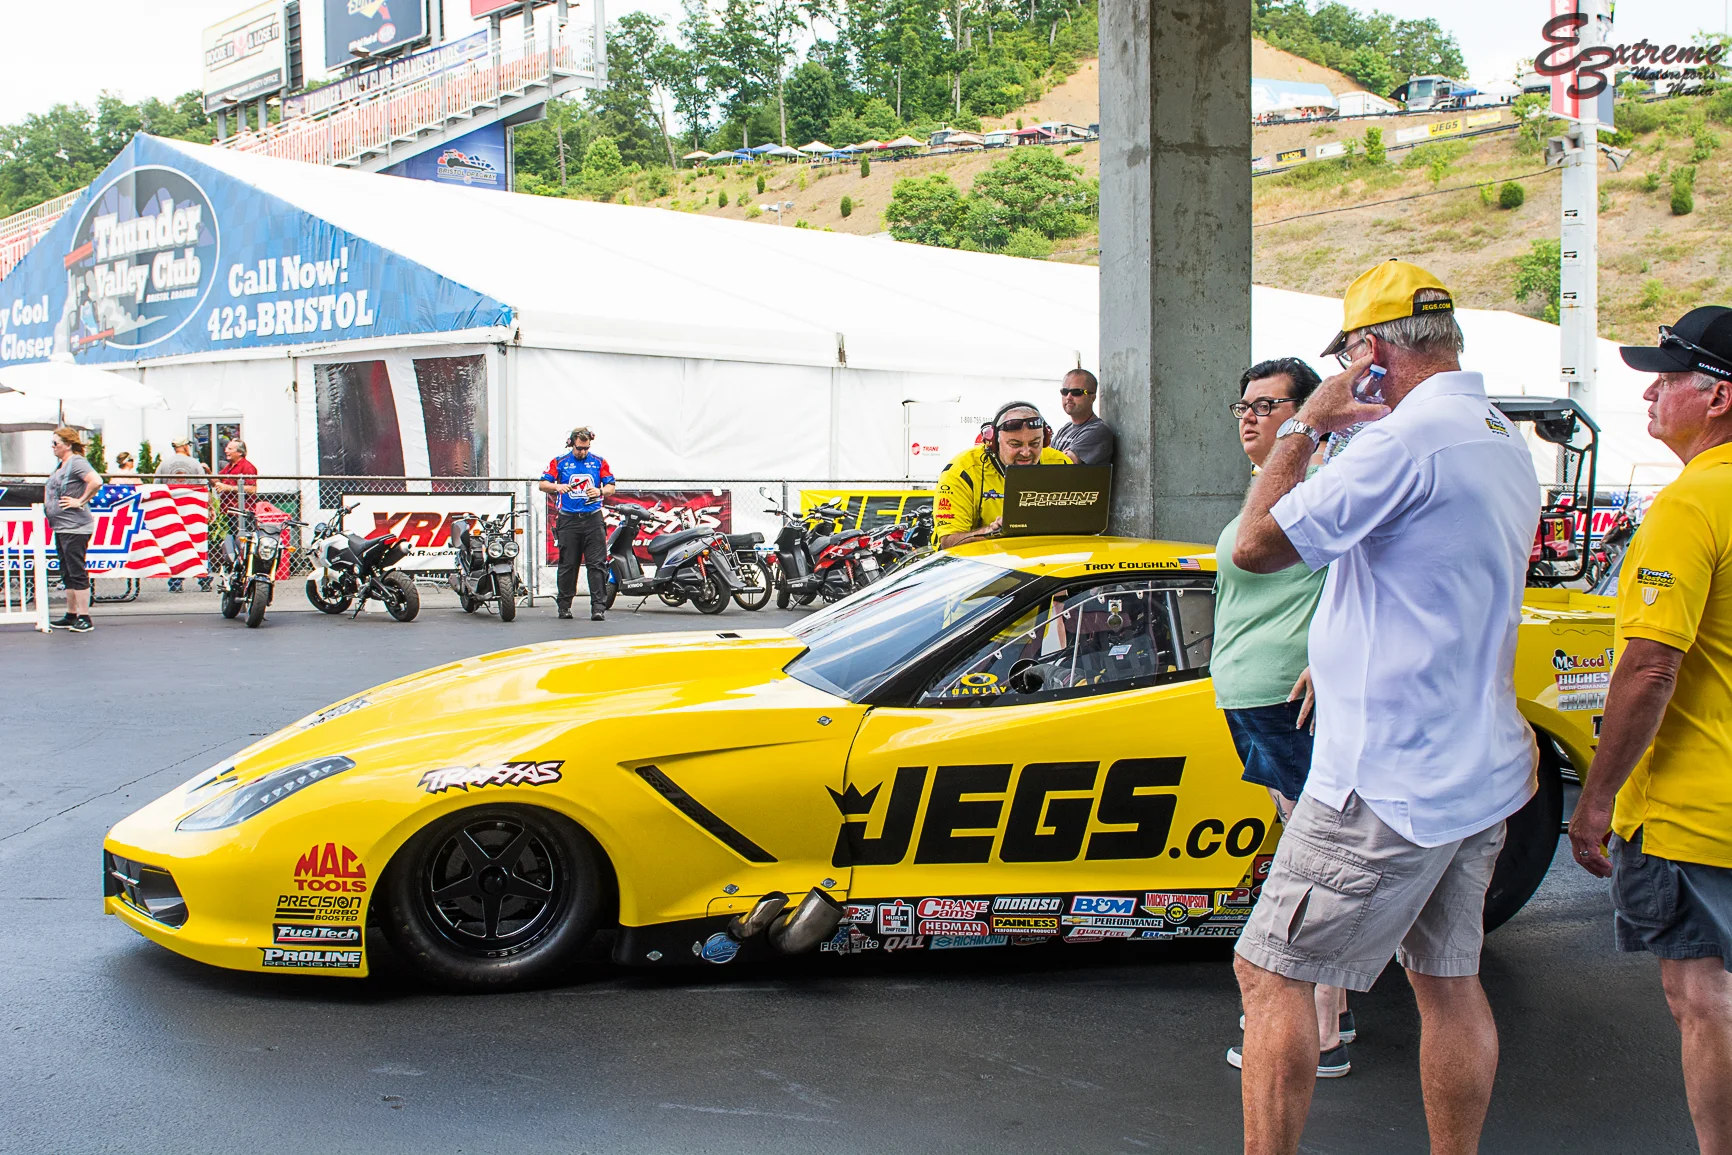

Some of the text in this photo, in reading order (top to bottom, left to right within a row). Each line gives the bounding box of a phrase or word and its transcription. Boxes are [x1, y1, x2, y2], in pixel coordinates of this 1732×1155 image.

[1432, 120, 1459, 133] JEGS
[438, 168, 497, 180] BRISTOL DRAGWAY
[94, 199, 202, 263] Thunder
[94, 247, 201, 304] Valley Club
[228, 246, 349, 298] Call Now!
[12, 294, 49, 326] Cool
[1421, 303, 1451, 311] JEGS.COM
[207, 289, 373, 341] 423-BRISTOL
[1, 333, 53, 361] Closer
[1697, 362, 1732, 377] OAKLEY
[1018, 491, 1100, 503] PROLINE
[1084, 561, 1179, 571] TROY COUGHLIN
[1642, 568, 1672, 579] Track
[1642, 575, 1676, 585] Tested
[1554, 654, 1606, 670] McLeod
[1559, 672, 1609, 685] HUGHES
[952, 686, 1008, 696] OAKLEY
[1558, 693, 1607, 710] GRANT
[420, 760, 563, 793] TRAXXAS
[294, 843, 367, 879] MAC
[294, 879, 368, 893] TOOLS
[277, 895, 362, 908] PRECISION
[995, 897, 1062, 911] MOROSO
[1072, 898, 1134, 914] B&M
[1147, 893, 1171, 906] MICKEY
[1172, 895, 1208, 908] THOMPSON
[917, 898, 989, 918] CRANE
[925, 921, 982, 932] HEDMAN
[995, 917, 1057, 928] PAINLESS
[1094, 917, 1163, 927] PERFORMANCE
[277, 926, 359, 940] FuelTech
[1076, 927, 1127, 937] QUICK FUEL
[883, 936, 926, 953] QA1
[953, 935, 1005, 947] RICHMOND
[263, 948, 362, 962] PROLINE
[264, 960, 360, 968] RACING.NET
